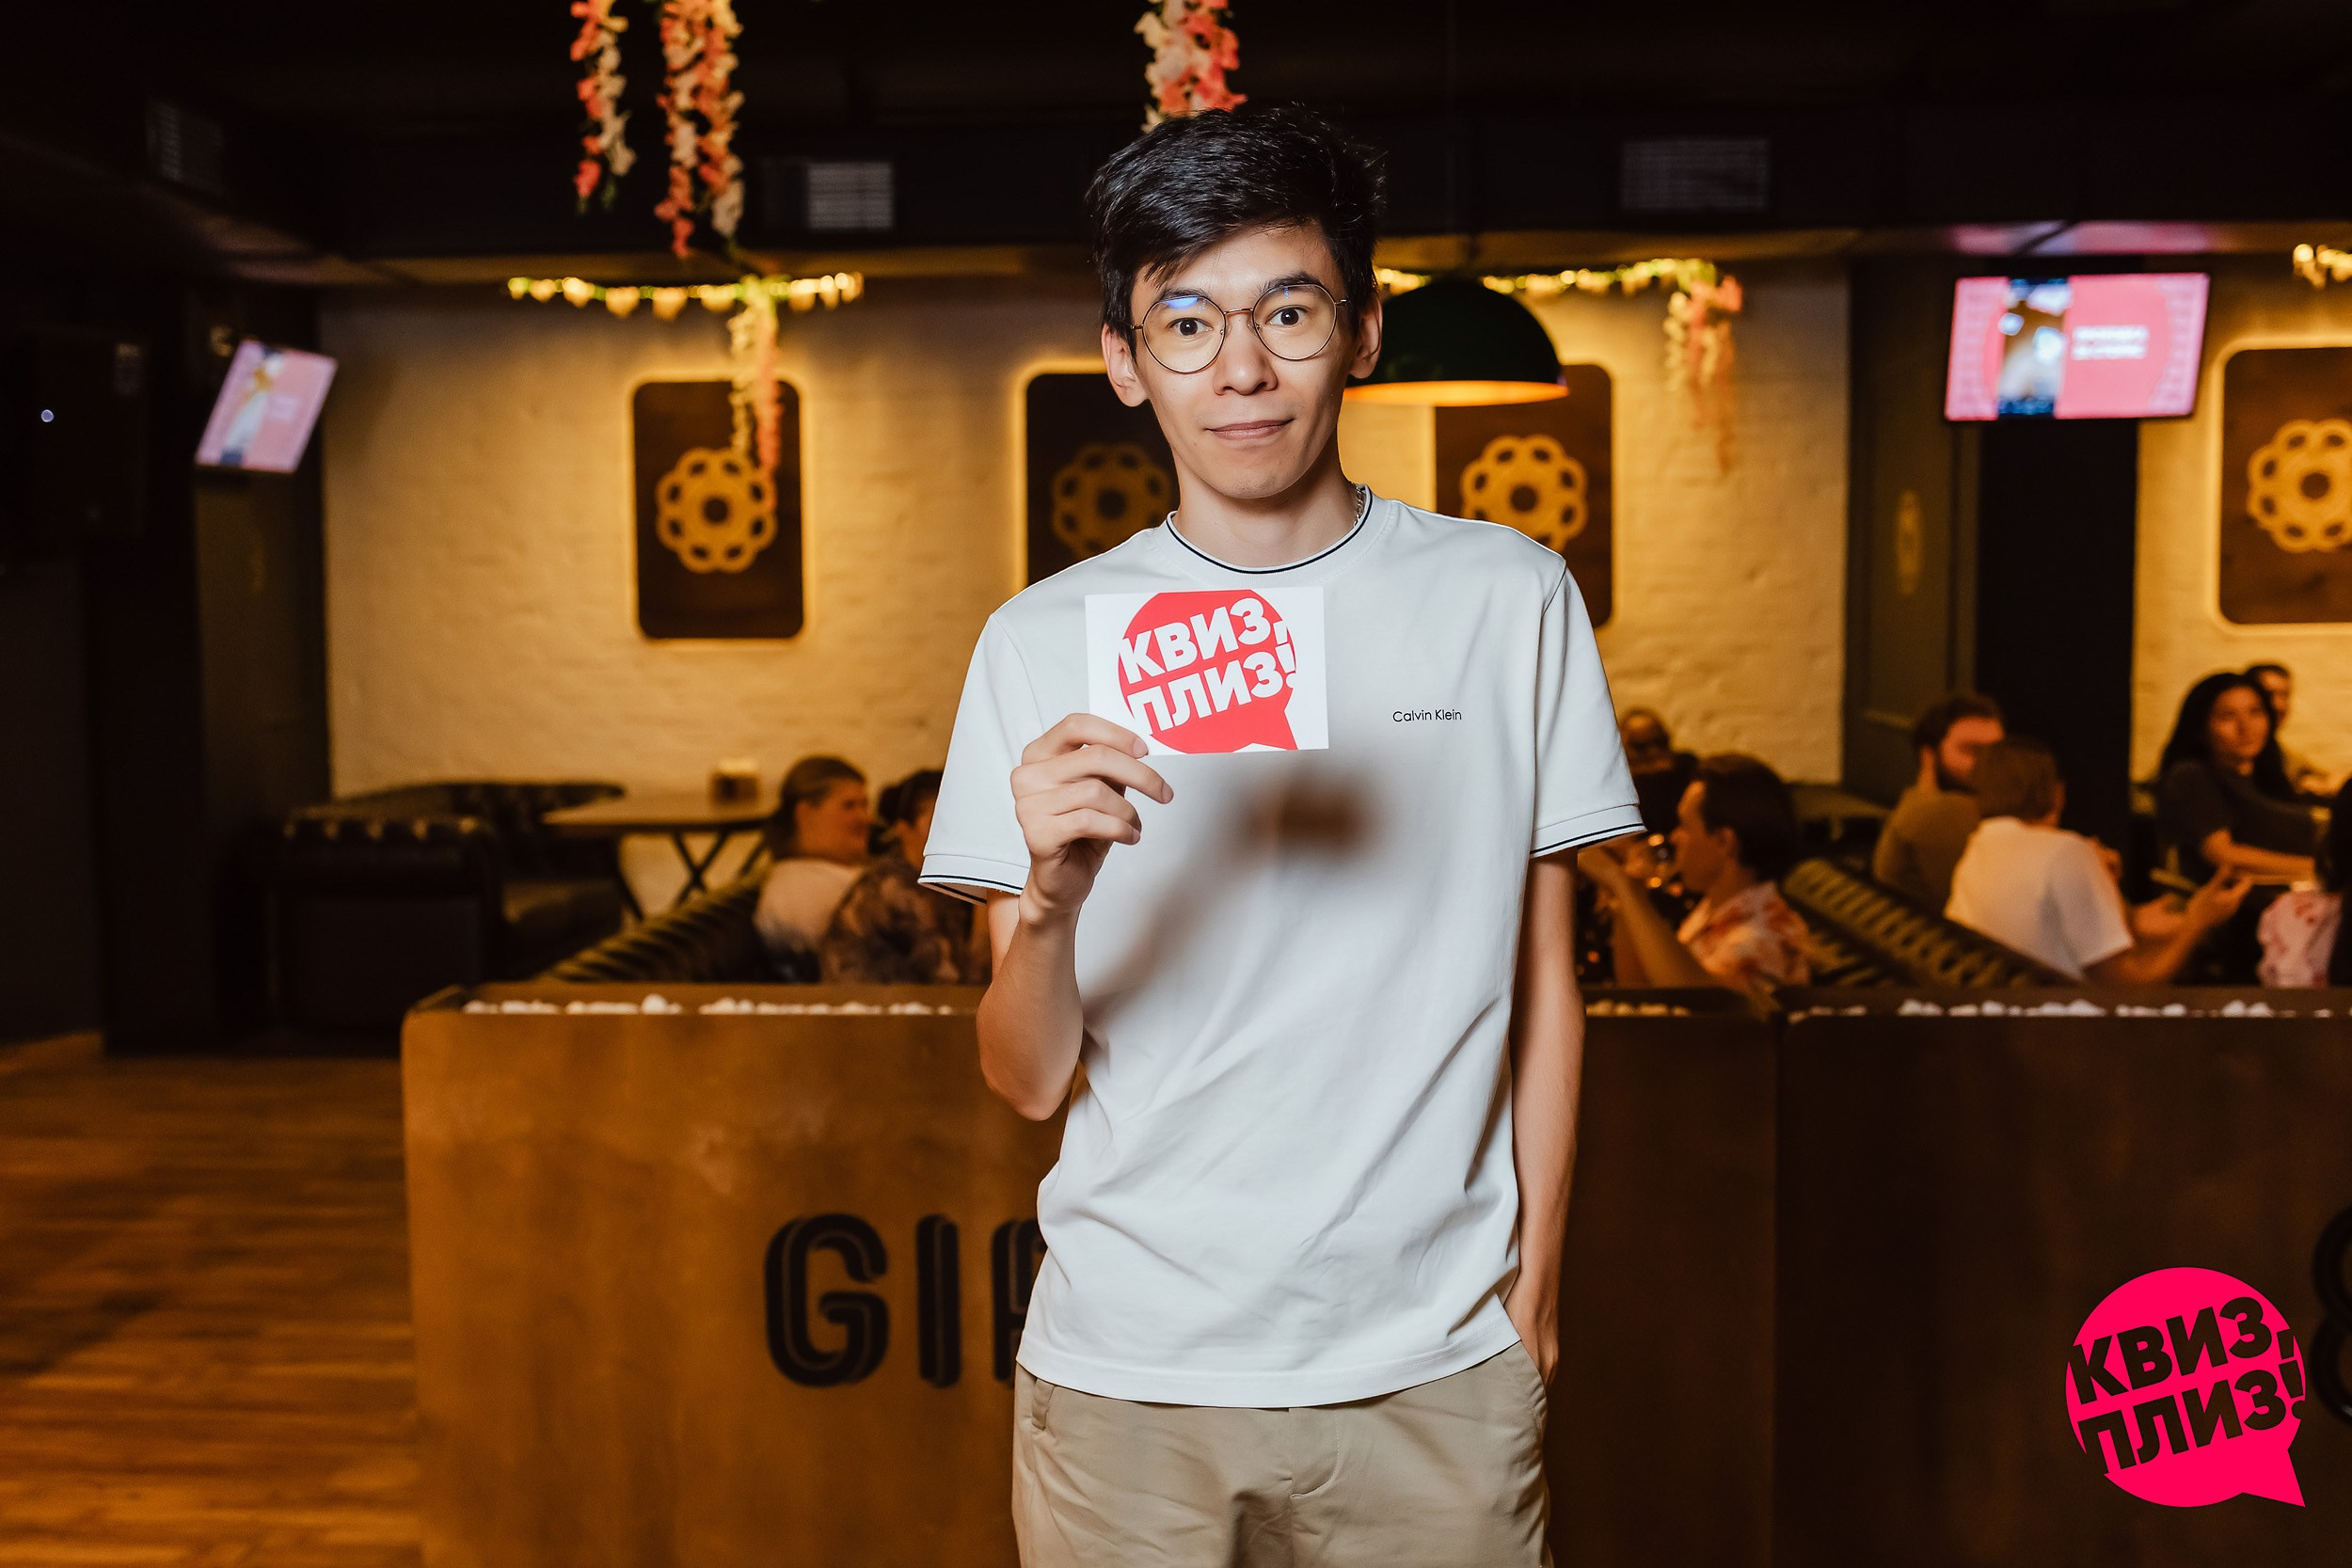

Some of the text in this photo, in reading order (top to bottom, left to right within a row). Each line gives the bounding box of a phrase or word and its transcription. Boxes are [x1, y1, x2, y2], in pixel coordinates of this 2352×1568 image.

[1127, 643, 1296, 736] ПЛИЗ!
[1392, 708, 1462, 722] Calvin Klein
